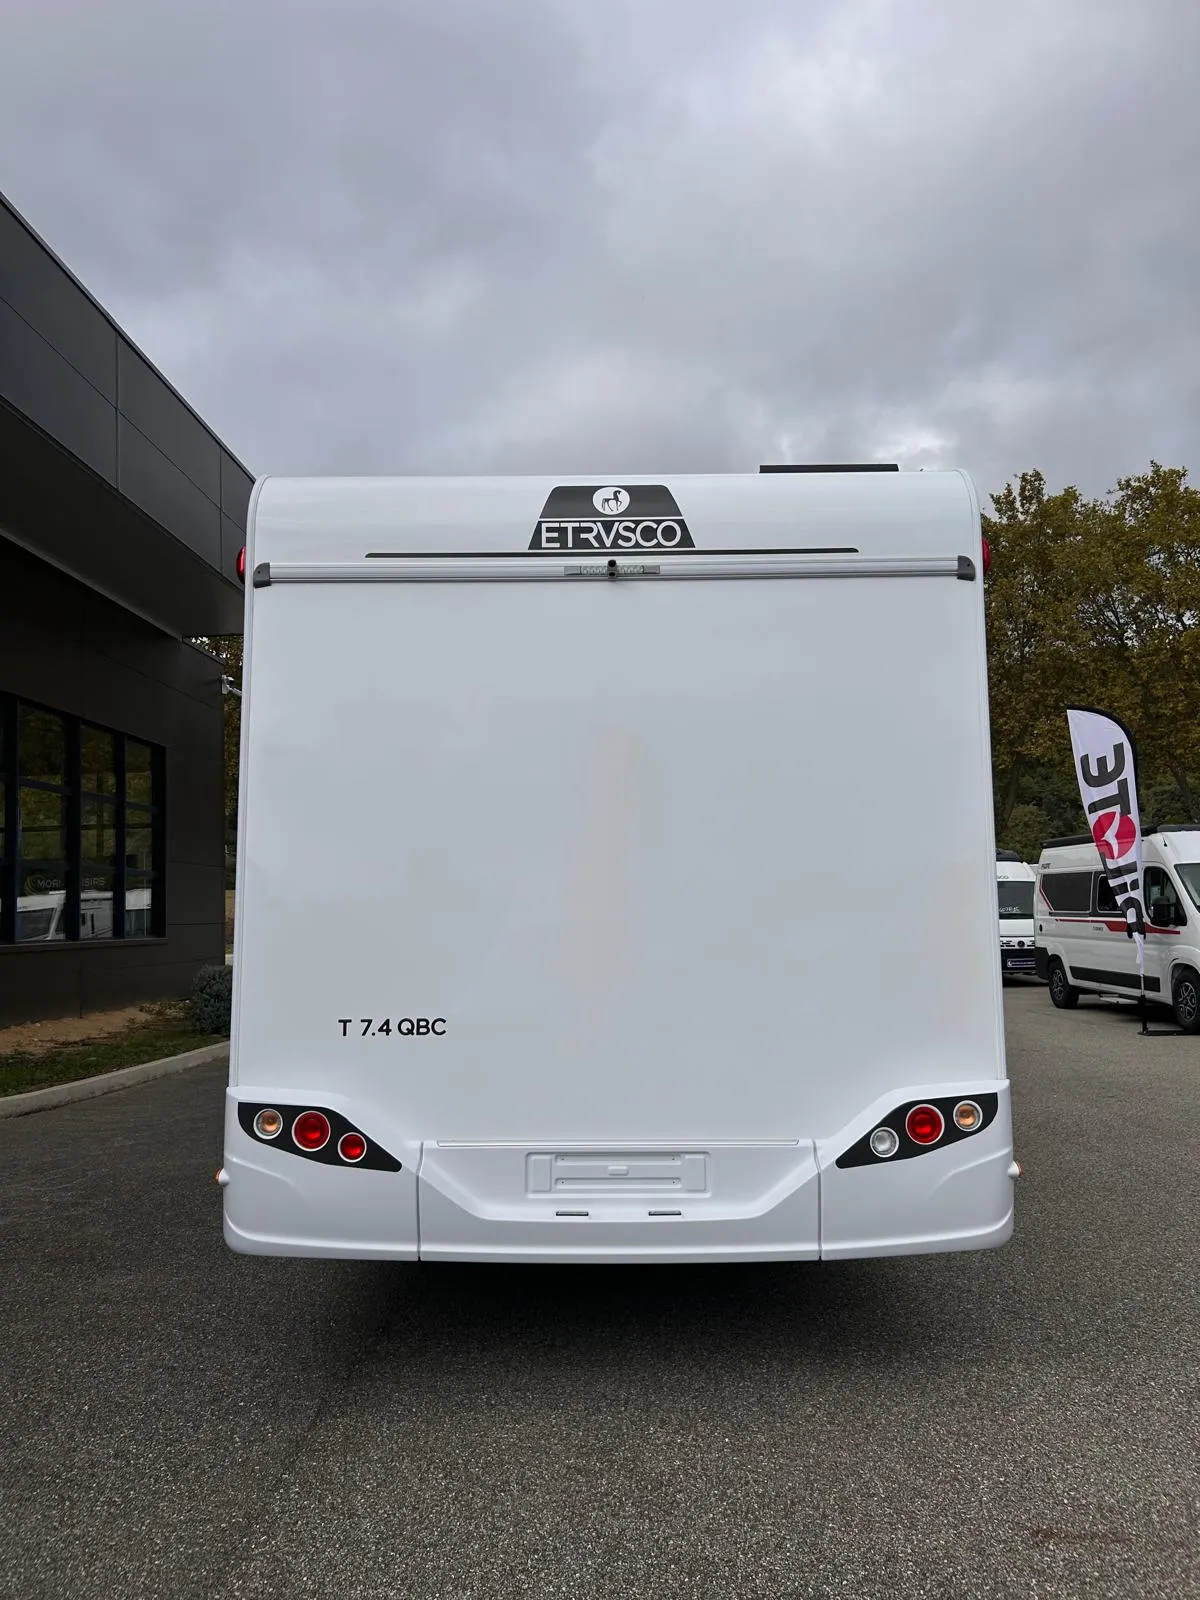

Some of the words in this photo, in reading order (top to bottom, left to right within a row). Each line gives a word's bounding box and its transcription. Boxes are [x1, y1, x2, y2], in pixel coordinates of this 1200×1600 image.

[541, 520, 682, 548] ETRVSCO
[338, 1019, 352, 1036] T
[360, 1019, 392, 1036] 7.4
[397, 1018, 447, 1036] QBC
